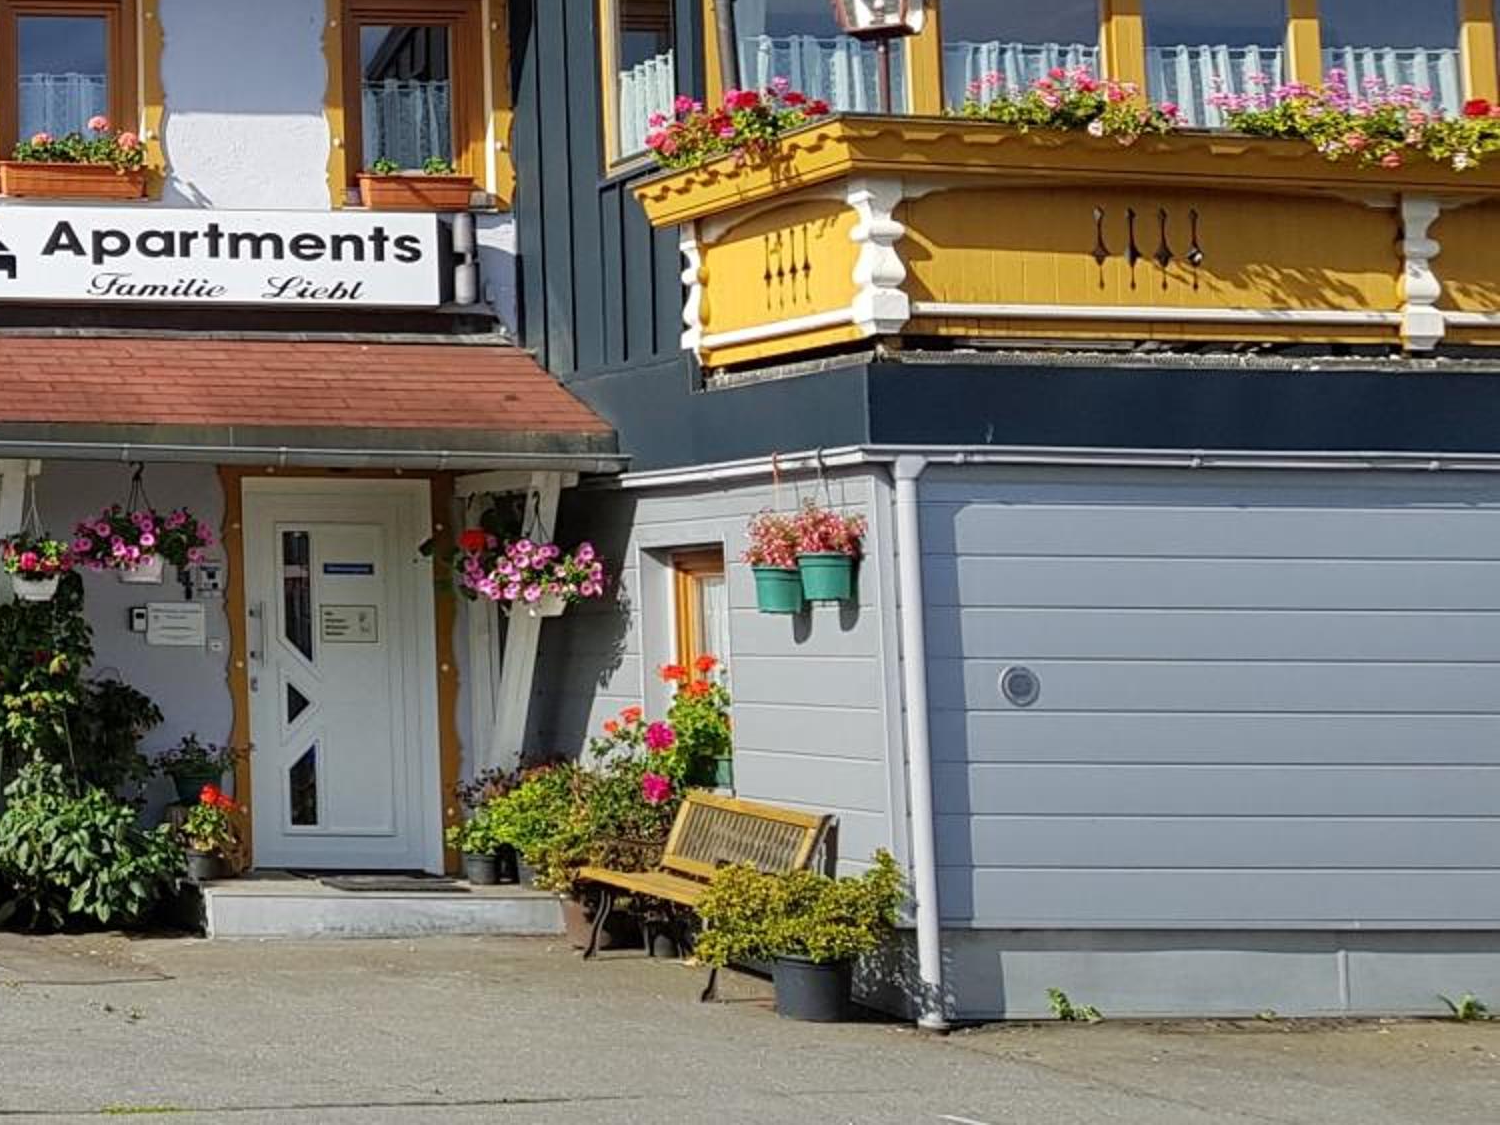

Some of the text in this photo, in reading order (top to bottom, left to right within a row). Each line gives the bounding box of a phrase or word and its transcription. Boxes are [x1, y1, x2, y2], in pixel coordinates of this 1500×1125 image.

[41, 220, 422, 265] Apartments
[87, 273, 365, 300] Familie Liebl
